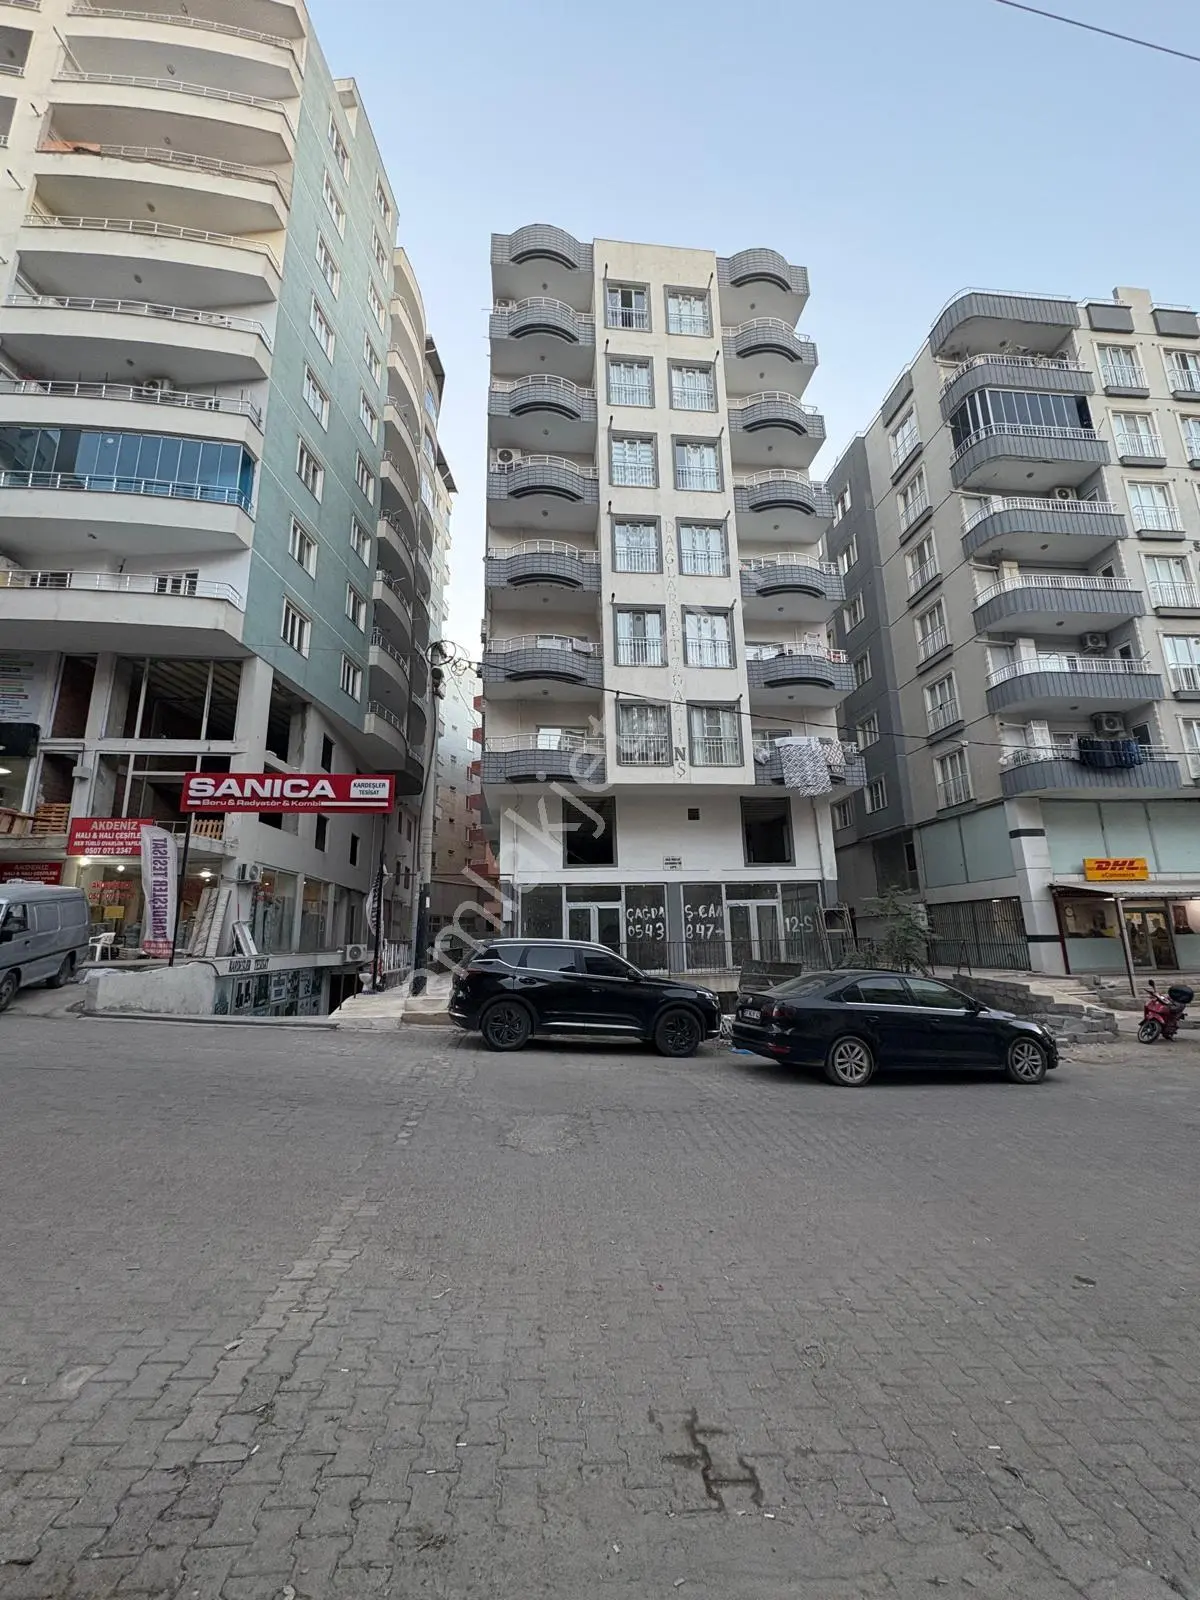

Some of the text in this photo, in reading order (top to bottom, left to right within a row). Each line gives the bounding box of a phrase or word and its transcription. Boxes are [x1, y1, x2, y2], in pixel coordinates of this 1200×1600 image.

[188, 777, 336, 799] SANICA
[352, 782, 386, 790] KARDEŞLER
[201, 799, 227, 807] Boru
[90, 819, 138, 831] AKDENİZ
[115, 831, 142, 841] ÇEŞİTLE
[1094, 860, 1140, 871] DHL
[627, 922, 665, 940] 0543
